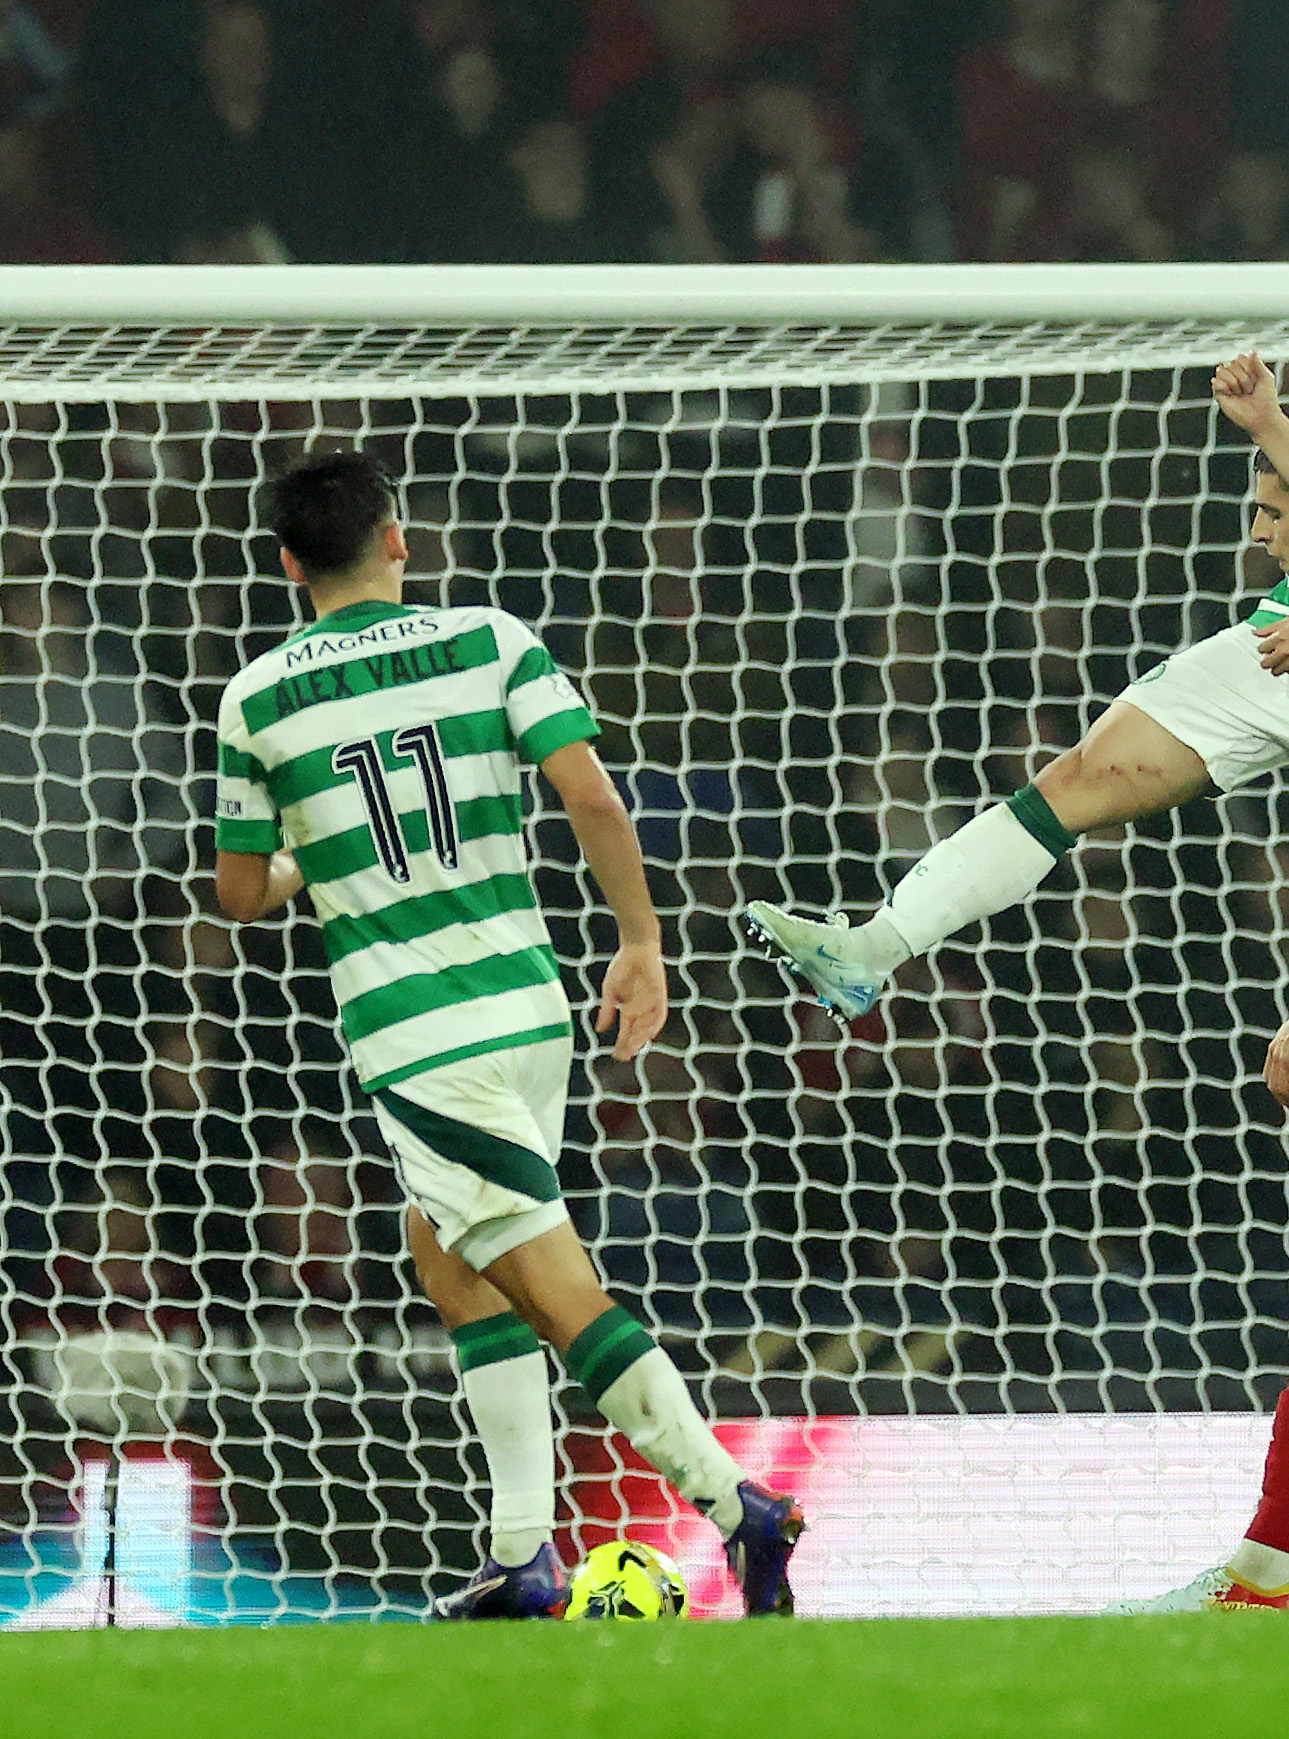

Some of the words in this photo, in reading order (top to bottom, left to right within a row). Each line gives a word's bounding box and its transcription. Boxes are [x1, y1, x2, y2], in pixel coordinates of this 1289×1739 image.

[286, 617, 439, 669] MAGNERS
[364, 639, 466, 687] VALLE
[332, 722, 461, 885] 11
